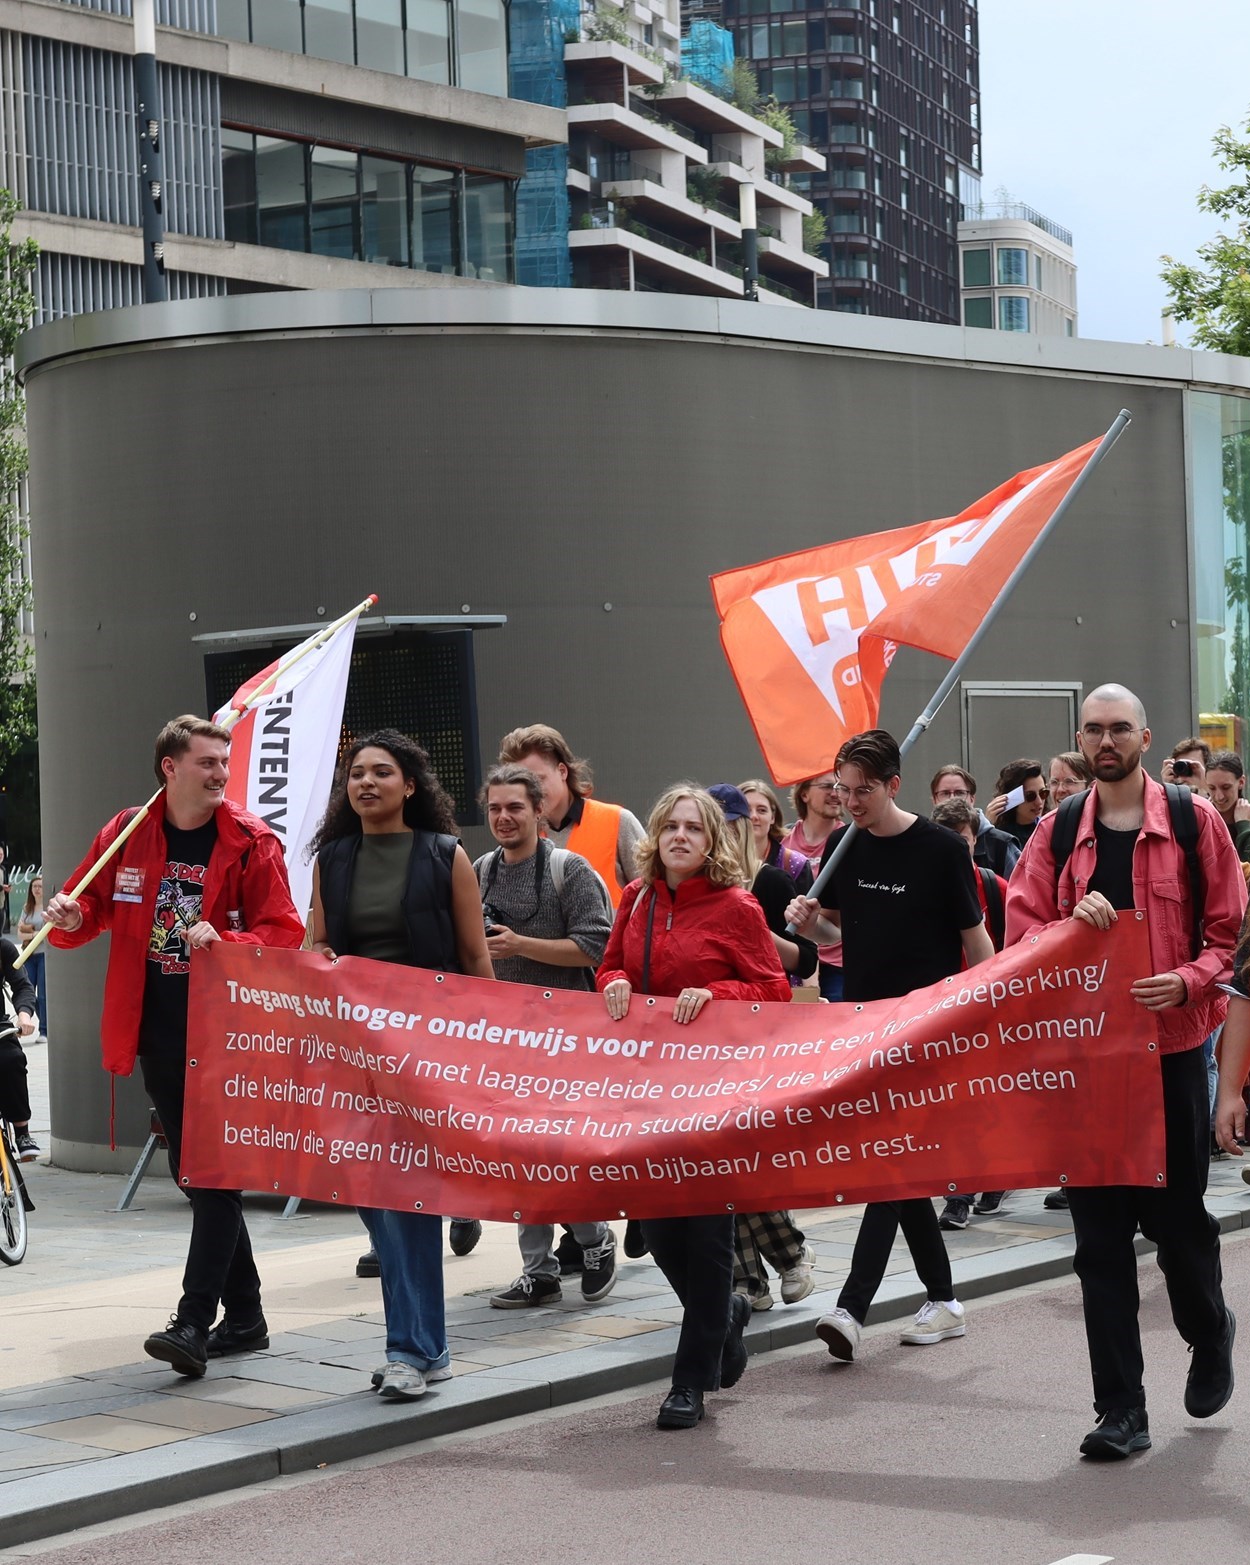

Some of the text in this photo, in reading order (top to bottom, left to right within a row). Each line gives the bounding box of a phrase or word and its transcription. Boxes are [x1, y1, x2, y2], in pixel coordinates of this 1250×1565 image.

[258, 689, 294, 853] ENTENV
[226, 1011, 1106, 1101] zonder rijke ouders/ met laagopgeleide ouders/ die van het mbo komen/
[227, 980, 305, 1018] Toegang
[304, 995, 333, 1018] tot
[337, 996, 422, 1031] hoger
[428, 1019, 578, 1057] onderwijs
[586, 1035, 654, 1058] voor
[660, 1042, 765, 1061] mensen
[772, 1038, 826, 1058] met
[830, 1031, 874, 1051] een
[224, 1068, 1077, 1138] die keihard moeten werken naast hun studie/ die te veel huur moeten
[224, 1120, 940, 1185] betalen/ die geen tijd hebben voor een bijbaan/ en de rest...
